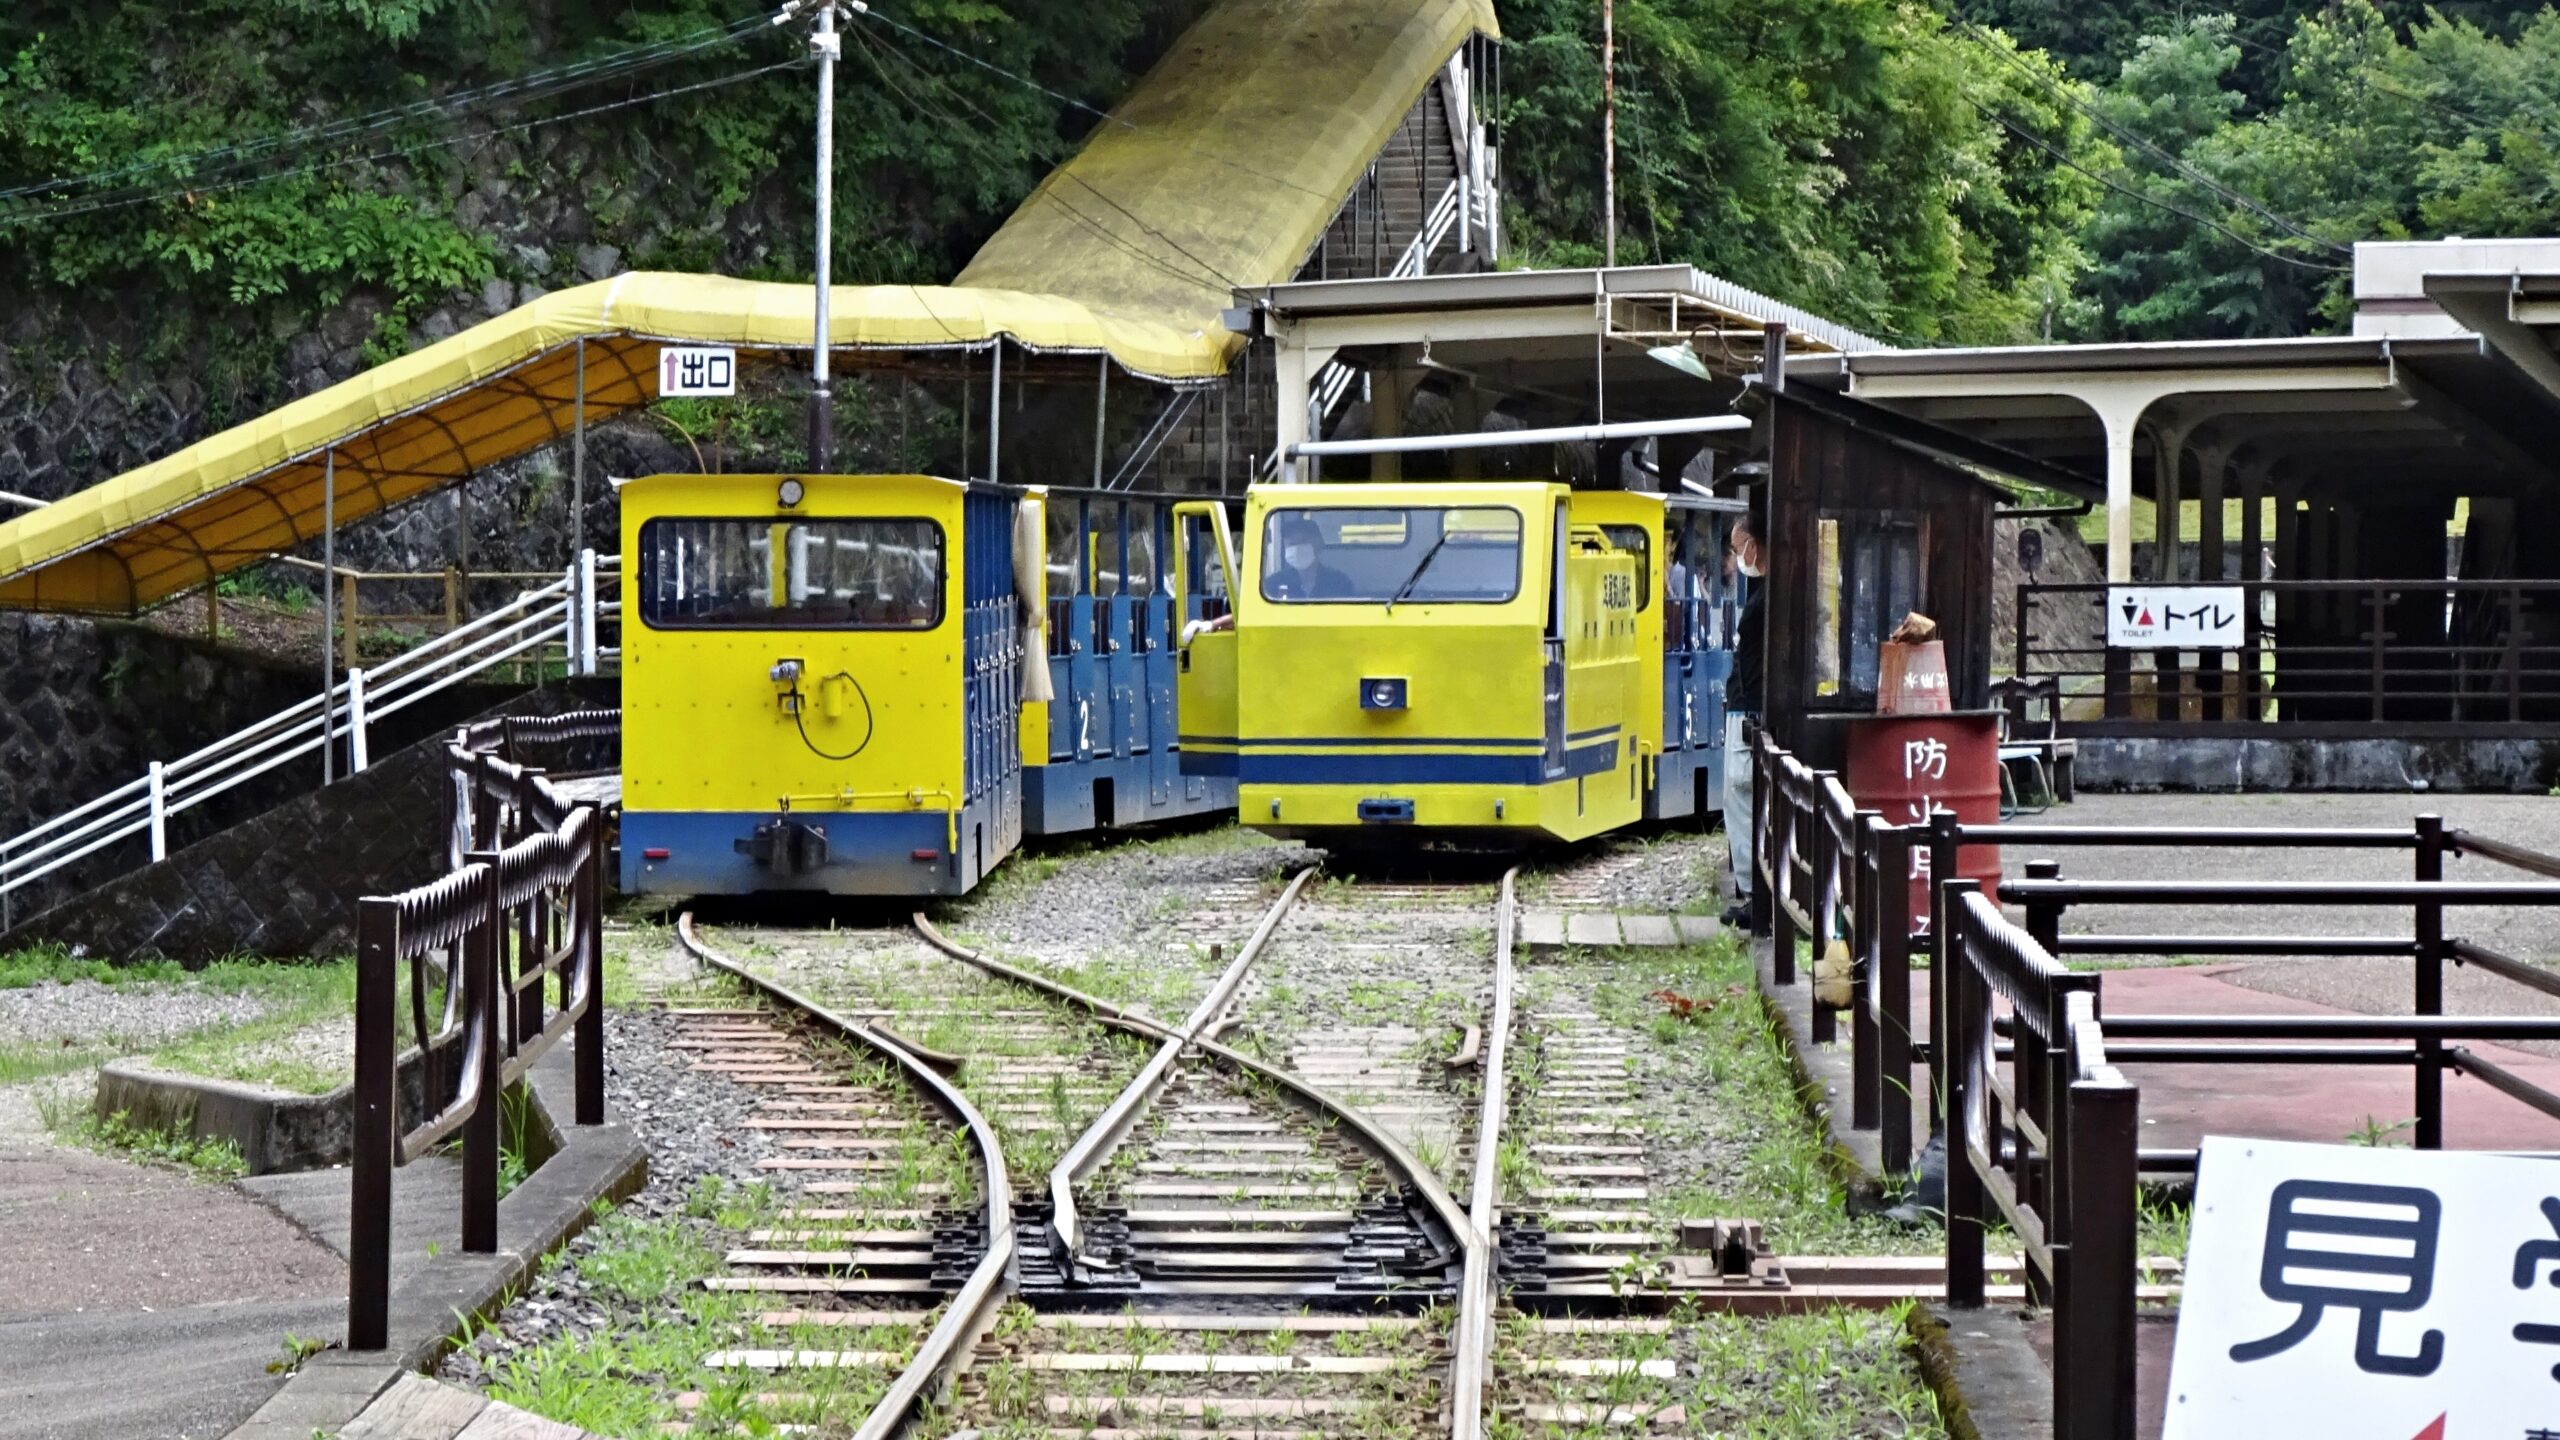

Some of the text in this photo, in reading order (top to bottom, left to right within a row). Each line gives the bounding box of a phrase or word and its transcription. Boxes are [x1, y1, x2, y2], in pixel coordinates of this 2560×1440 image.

[681, 352, 731, 389] 出口
[2122, 629, 2154, 638] TOILET
[2164, 604, 2236, 631] トイレ
[1080, 700, 1089, 750] 2
[1685, 693, 1692, 741] 5
[2228, 1178, 2560, 1386] 見
